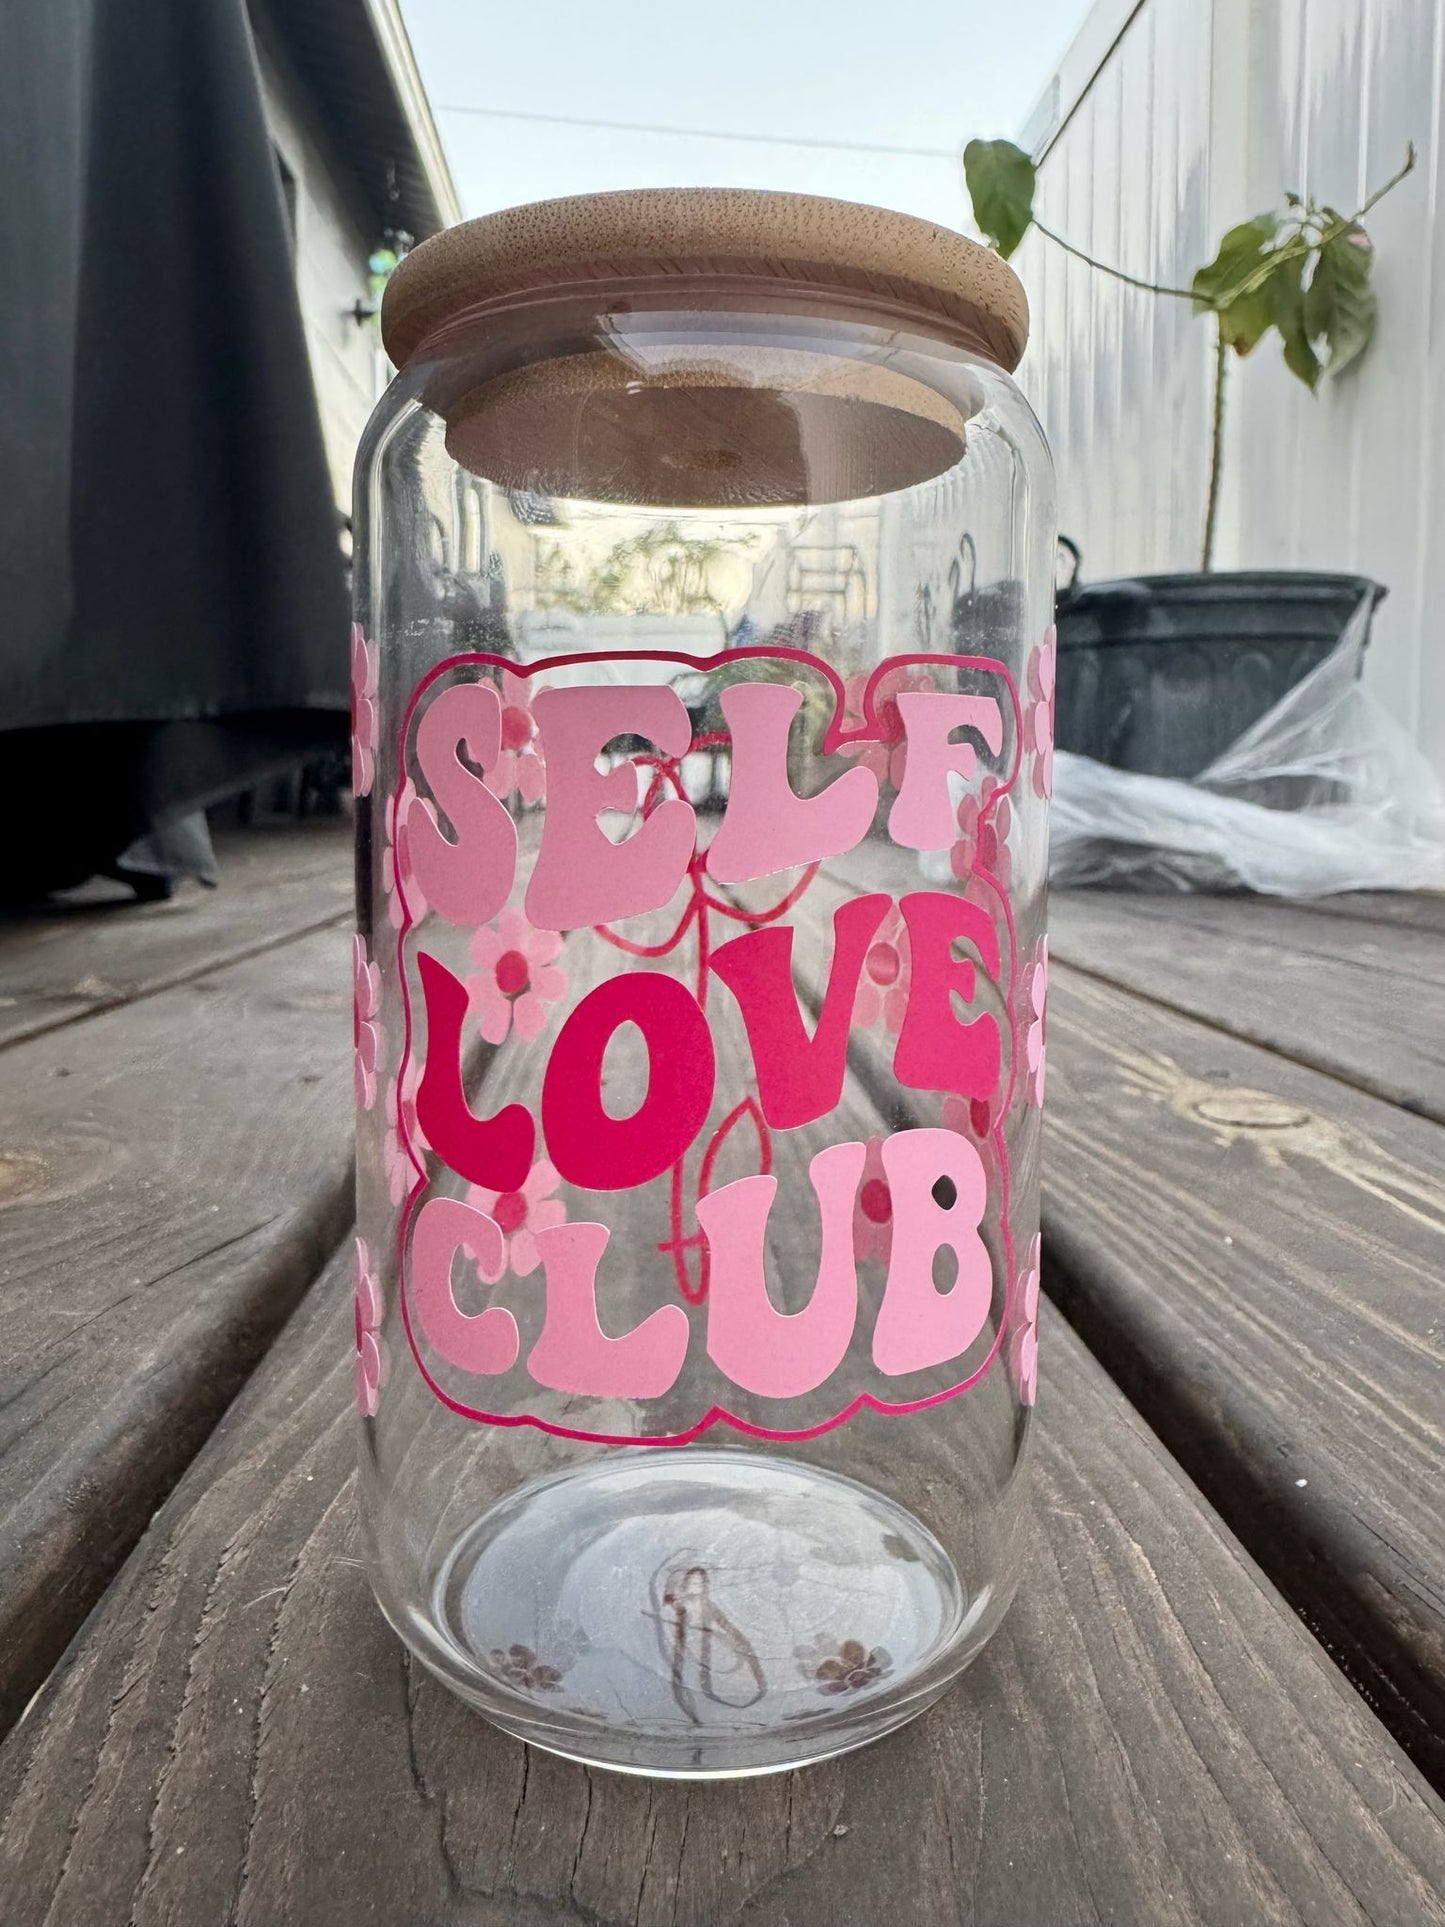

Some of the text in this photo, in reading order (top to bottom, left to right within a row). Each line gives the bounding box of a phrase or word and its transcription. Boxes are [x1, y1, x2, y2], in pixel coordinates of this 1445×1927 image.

[408, 684, 1002, 931] SELF
[417, 892, 1000, 1191] LOVE
[412, 1128, 993, 1399] CLUB
